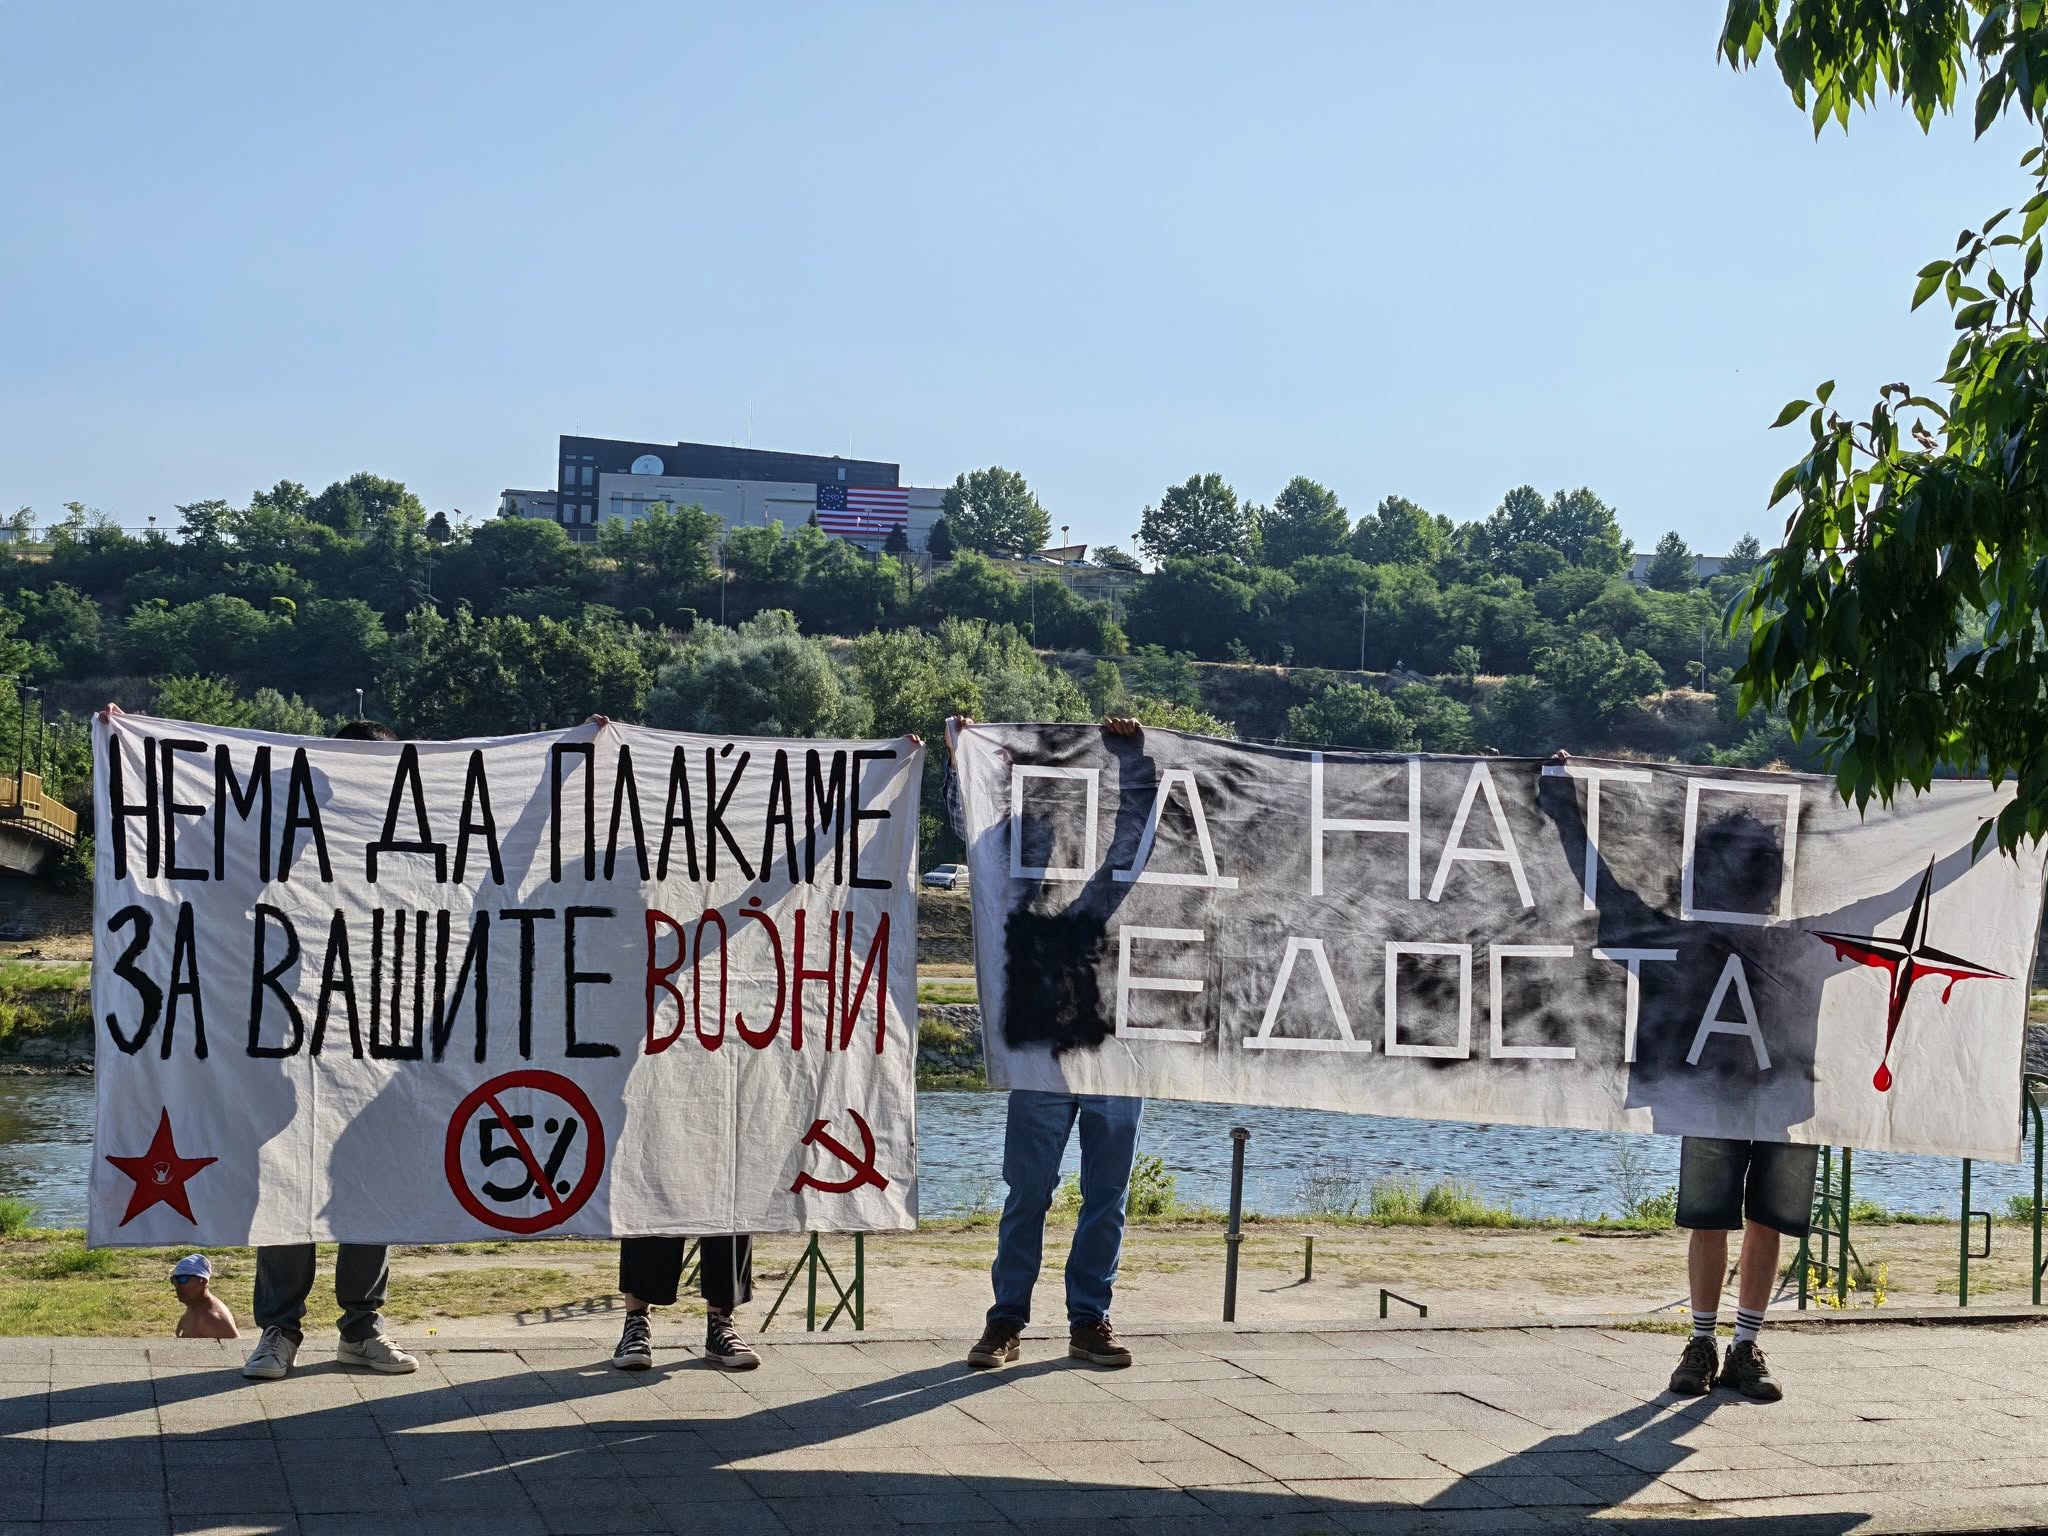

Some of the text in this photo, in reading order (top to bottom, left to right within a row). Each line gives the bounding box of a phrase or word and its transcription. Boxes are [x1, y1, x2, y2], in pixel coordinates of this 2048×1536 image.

[109, 735, 896, 890] НЕМА ДА ПЛАЌАМЕ
[1012, 752, 1801, 925] ОД НАТО
[106, 897, 890, 1062] ЗА ВАШИТЕ ВОЈНИ
[479, 1115, 578, 1202] 5%
